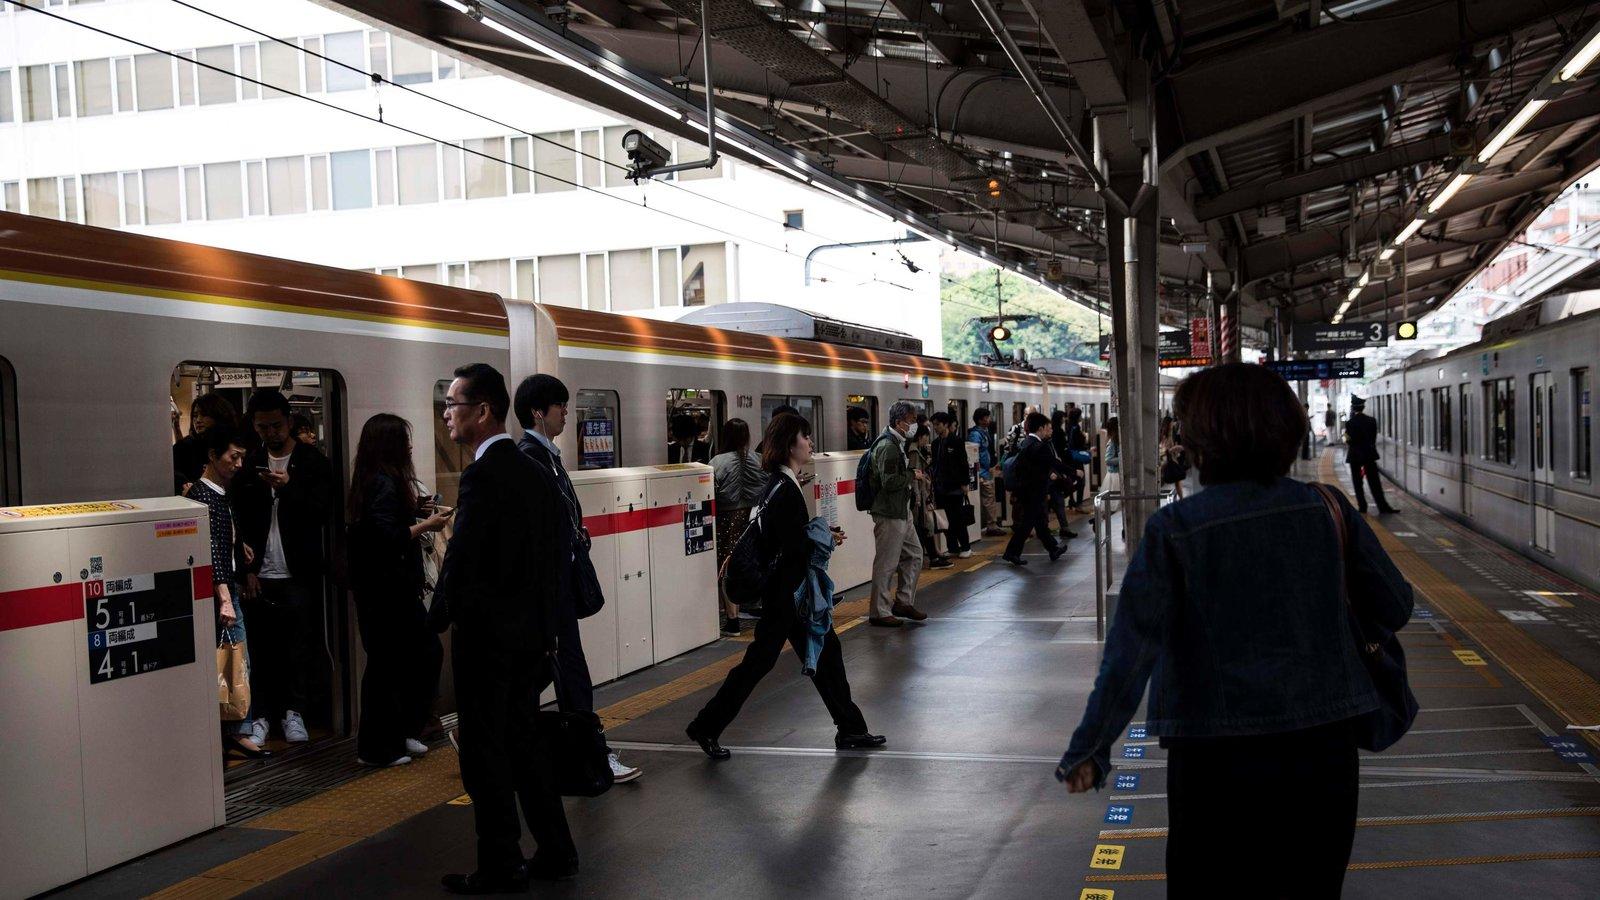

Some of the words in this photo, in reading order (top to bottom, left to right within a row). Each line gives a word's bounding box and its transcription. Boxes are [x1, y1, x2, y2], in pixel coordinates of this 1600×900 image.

[1369, 322, 1382, 341] 3
[88, 582, 101, 596] 10
[106, 579, 133, 593] 両編成
[95, 599, 111, 630] 5
[128, 601, 136, 624] 1
[94, 633, 101, 647] 8
[108, 629, 135, 644] 両編成
[97, 648, 114, 679] 4
[131, 650, 139, 673] 1
